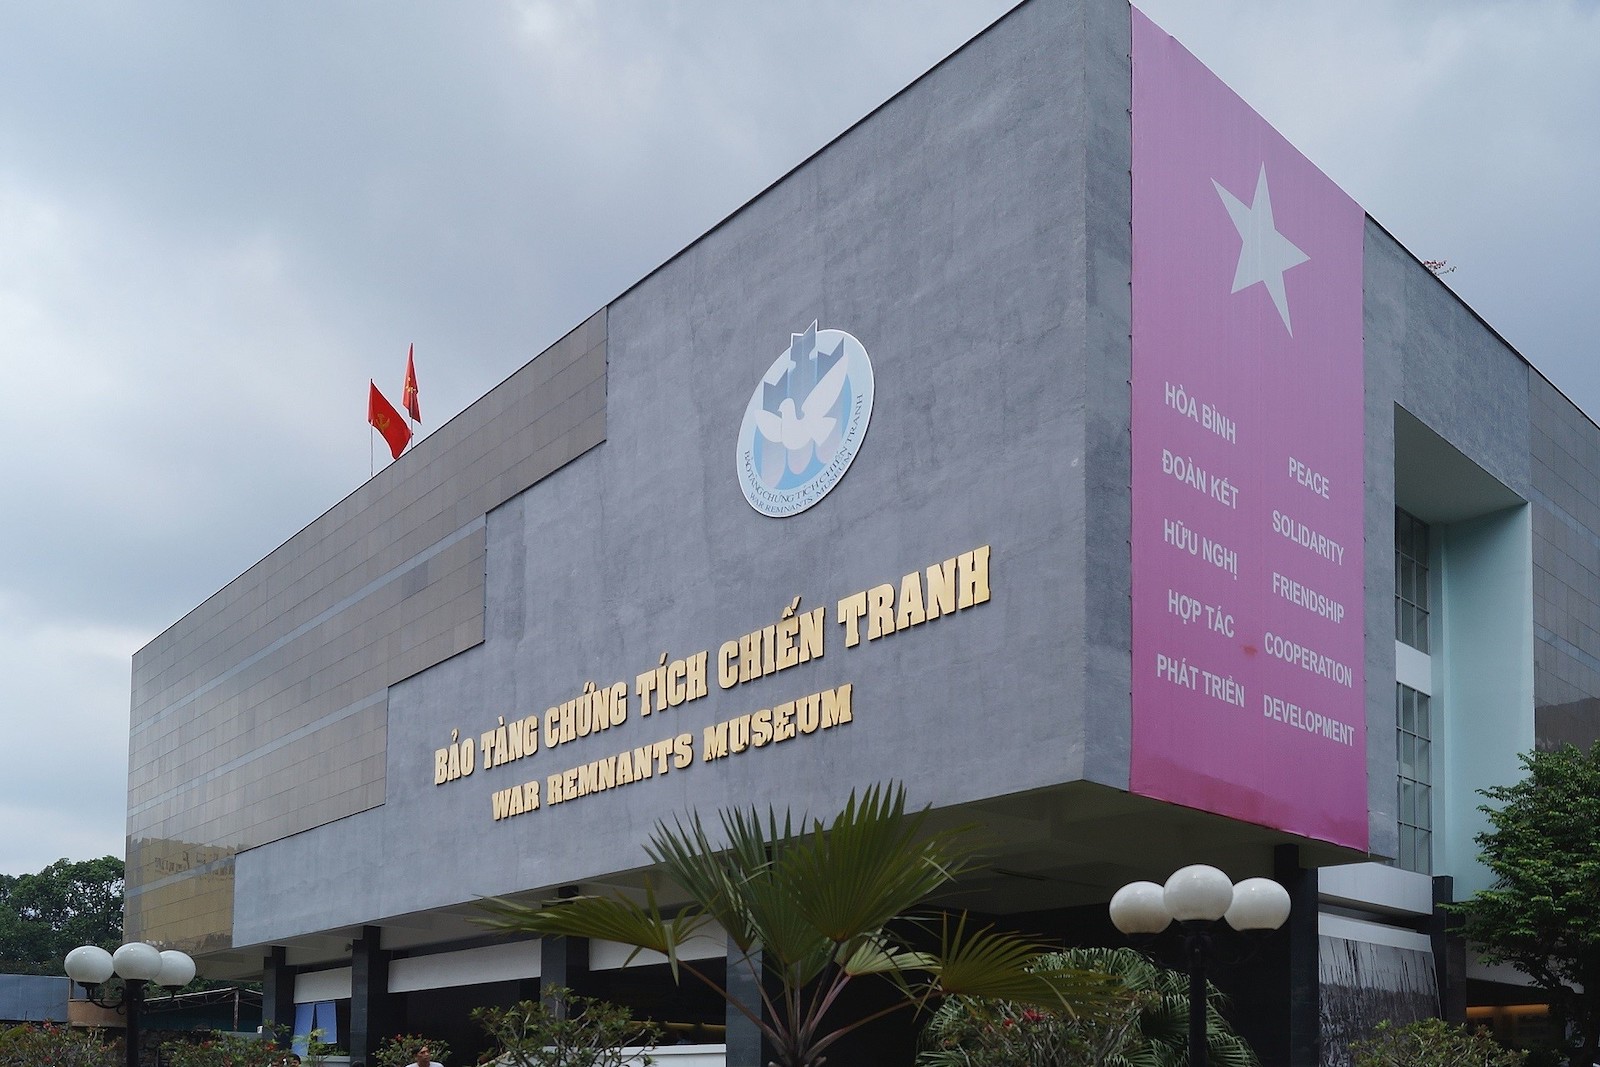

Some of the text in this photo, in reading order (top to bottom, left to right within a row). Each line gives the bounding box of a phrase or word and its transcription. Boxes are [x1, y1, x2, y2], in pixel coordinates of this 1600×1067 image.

[846, 393, 863, 442] TRANH
[1165, 381, 1236, 444] HÒA BÌNH
[750, 492, 764, 508] WAR
[1162, 448, 1239, 510] ĐOÀN KẾT
[1289, 456, 1330, 500] PEACE
[1164, 518, 1237, 580] HỮU NGHỊ
[1272, 509, 1344, 566] SOLIDARITY
[1168, 589, 1235, 638] HỢP TÁC
[1273, 572, 1344, 624] FRIENDSHIP
[434, 545, 991, 785] BẢO TÀNG CHỨNG TÍCH CHIẾN TRANH
[1157, 653, 1199, 691] PHÁT
[1264, 632, 1352, 688] COOPERATION
[1263, 694, 1354, 746] DEVELOPMENT
[491, 683, 852, 821] WAR REMNANTS MUSEUM
